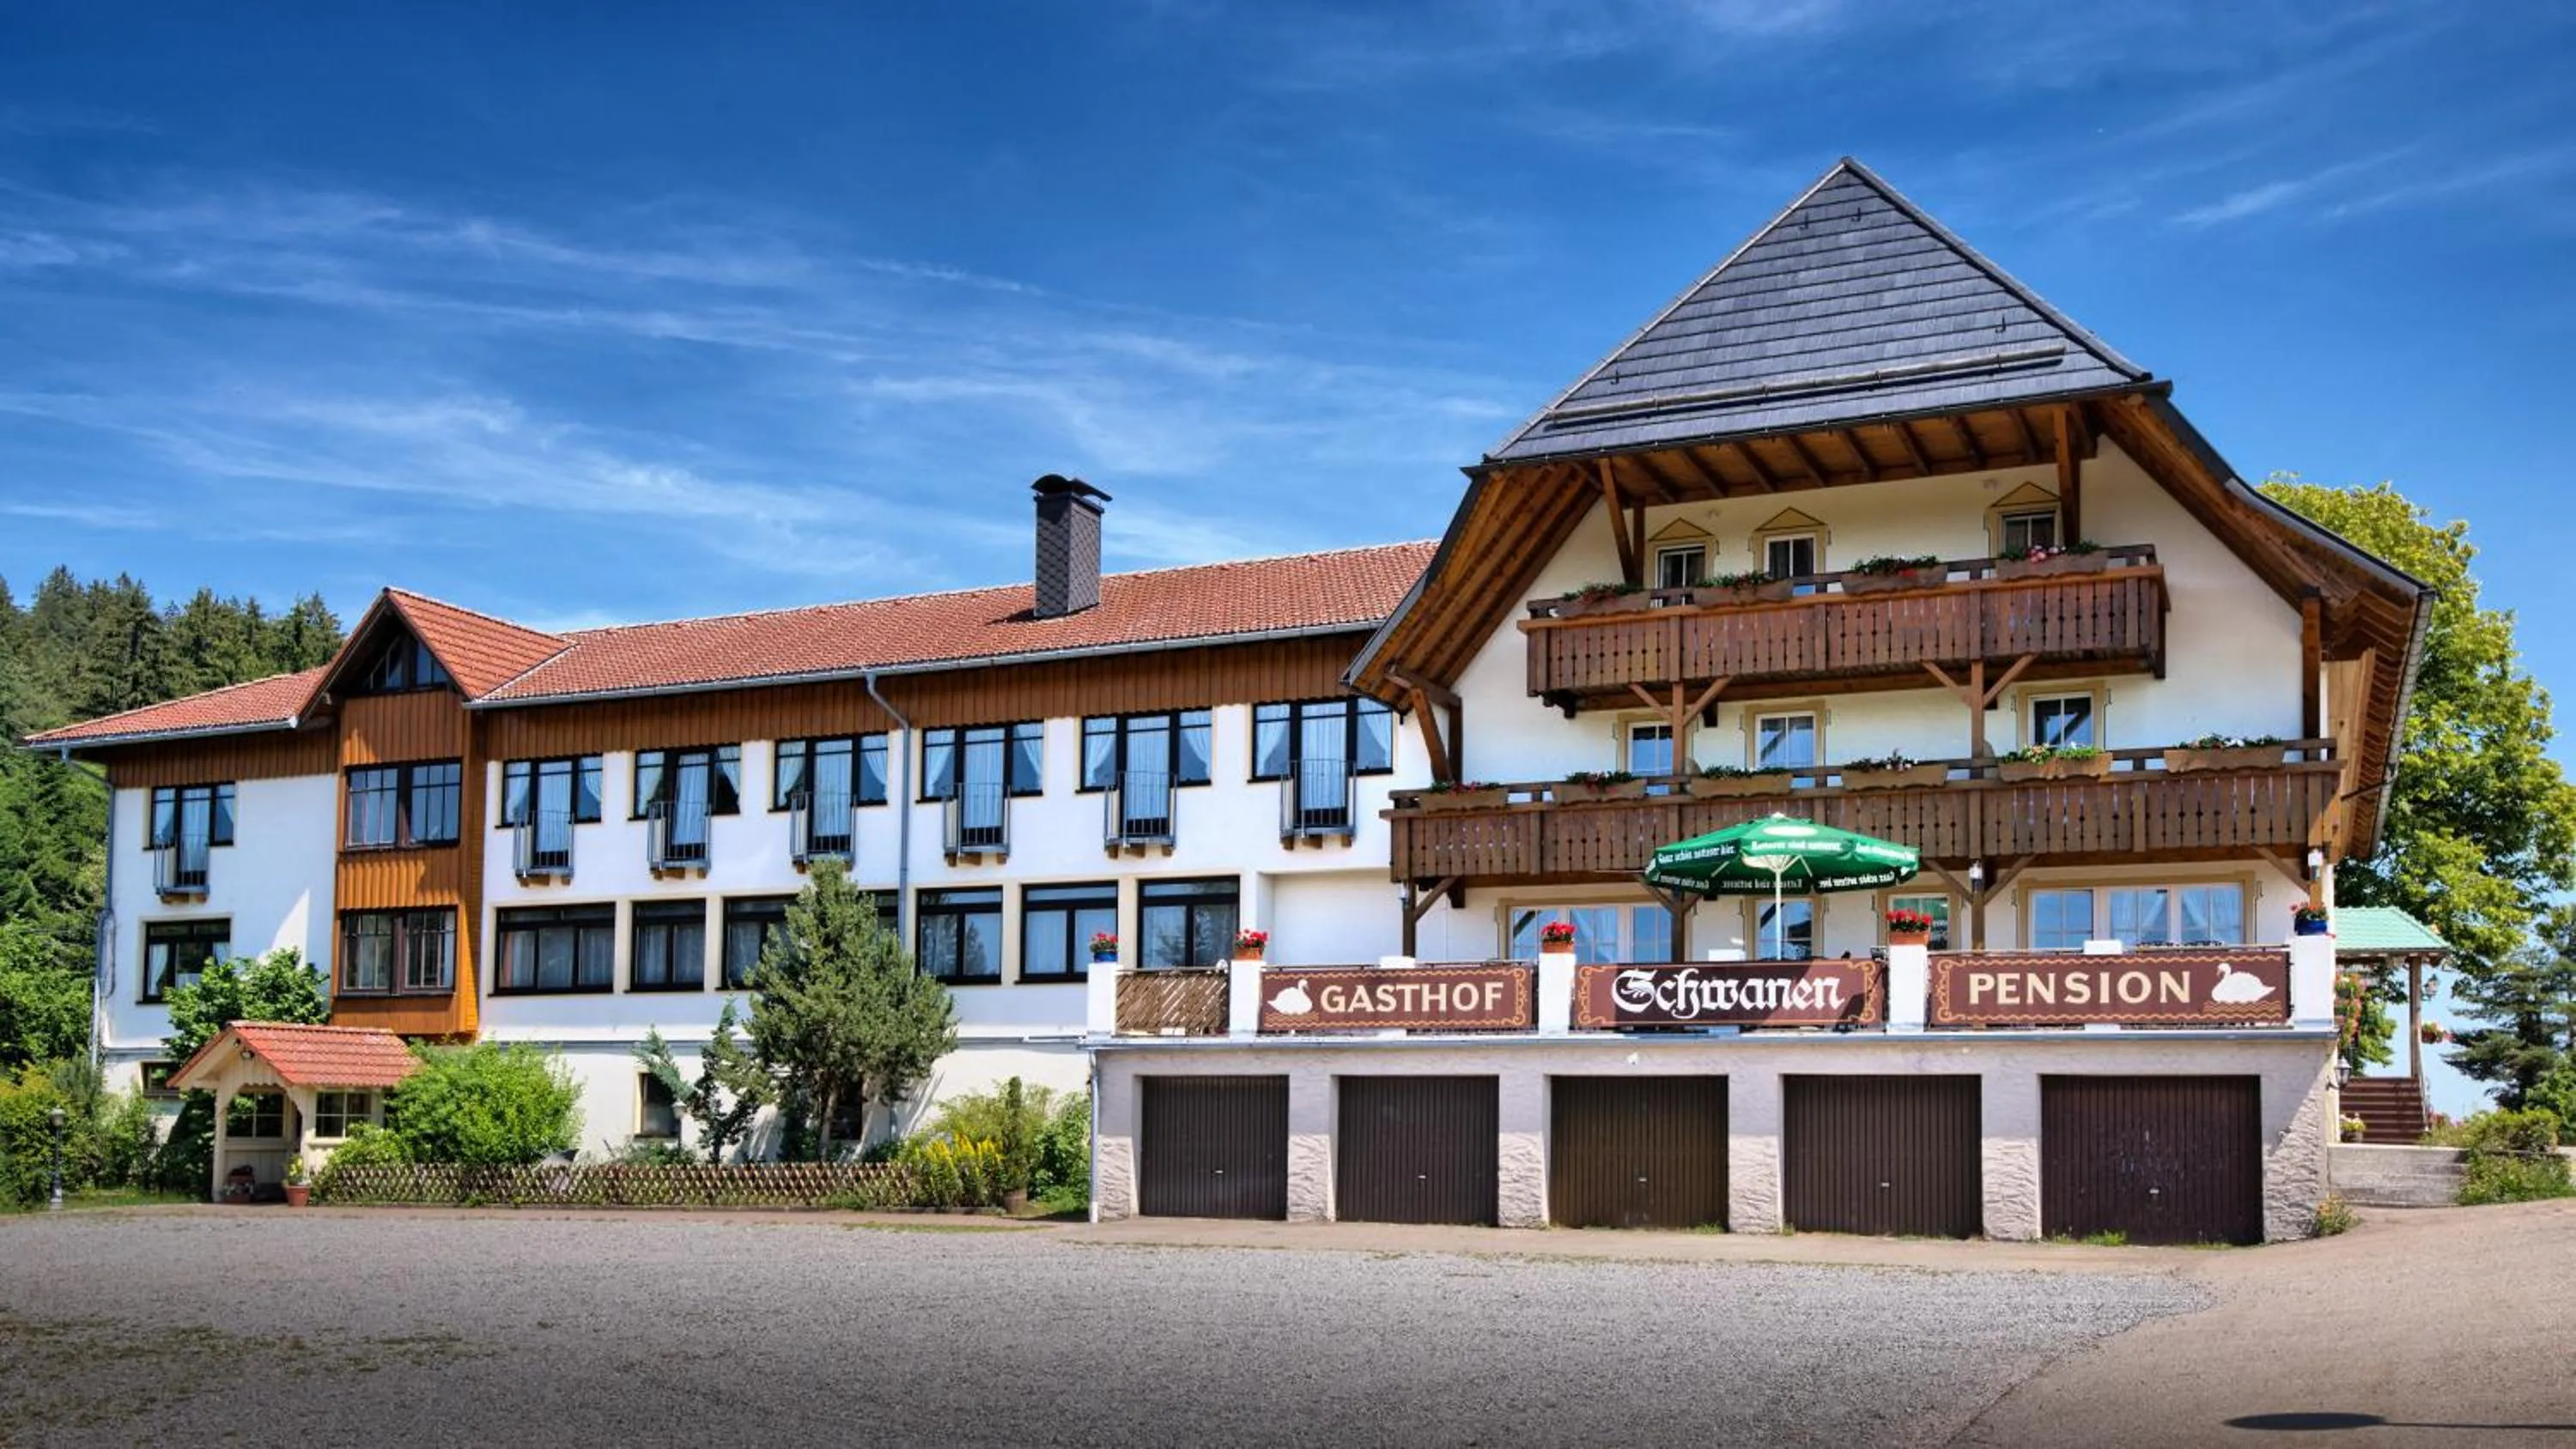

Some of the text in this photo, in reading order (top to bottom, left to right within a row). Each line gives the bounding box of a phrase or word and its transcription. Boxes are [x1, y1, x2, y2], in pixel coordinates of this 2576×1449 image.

[1320, 981, 1504, 1014] GASTHOF
[1611, 967, 1845, 1020] Schwanen
[1969, 971, 2190, 1004] PENSION
